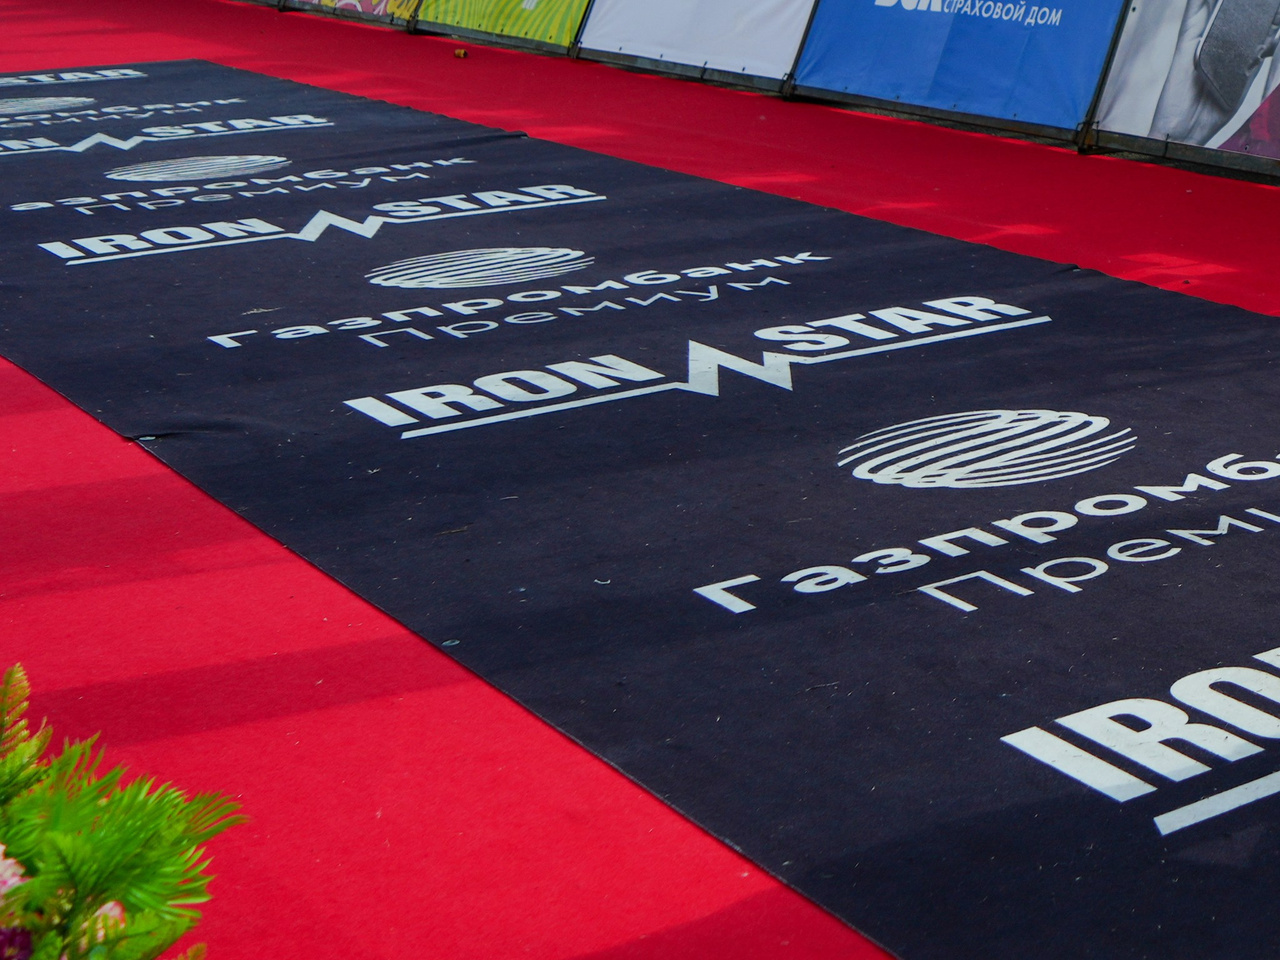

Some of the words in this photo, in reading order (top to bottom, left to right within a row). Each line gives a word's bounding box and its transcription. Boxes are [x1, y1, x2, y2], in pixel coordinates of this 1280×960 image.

[1025, 6, 1062, 26] ДОМ
[142, 114, 323, 137] STAR
[37, 218, 285, 258] IRON
[373, 184, 597, 218] STAR
[75, 172, 430, 215] Премиум
[207, 251, 832, 348] Газпромбанк
[358, 277, 790, 347] Премиум
[343, 353, 665, 427] IRON
[754, 295, 1029, 350] STAR
